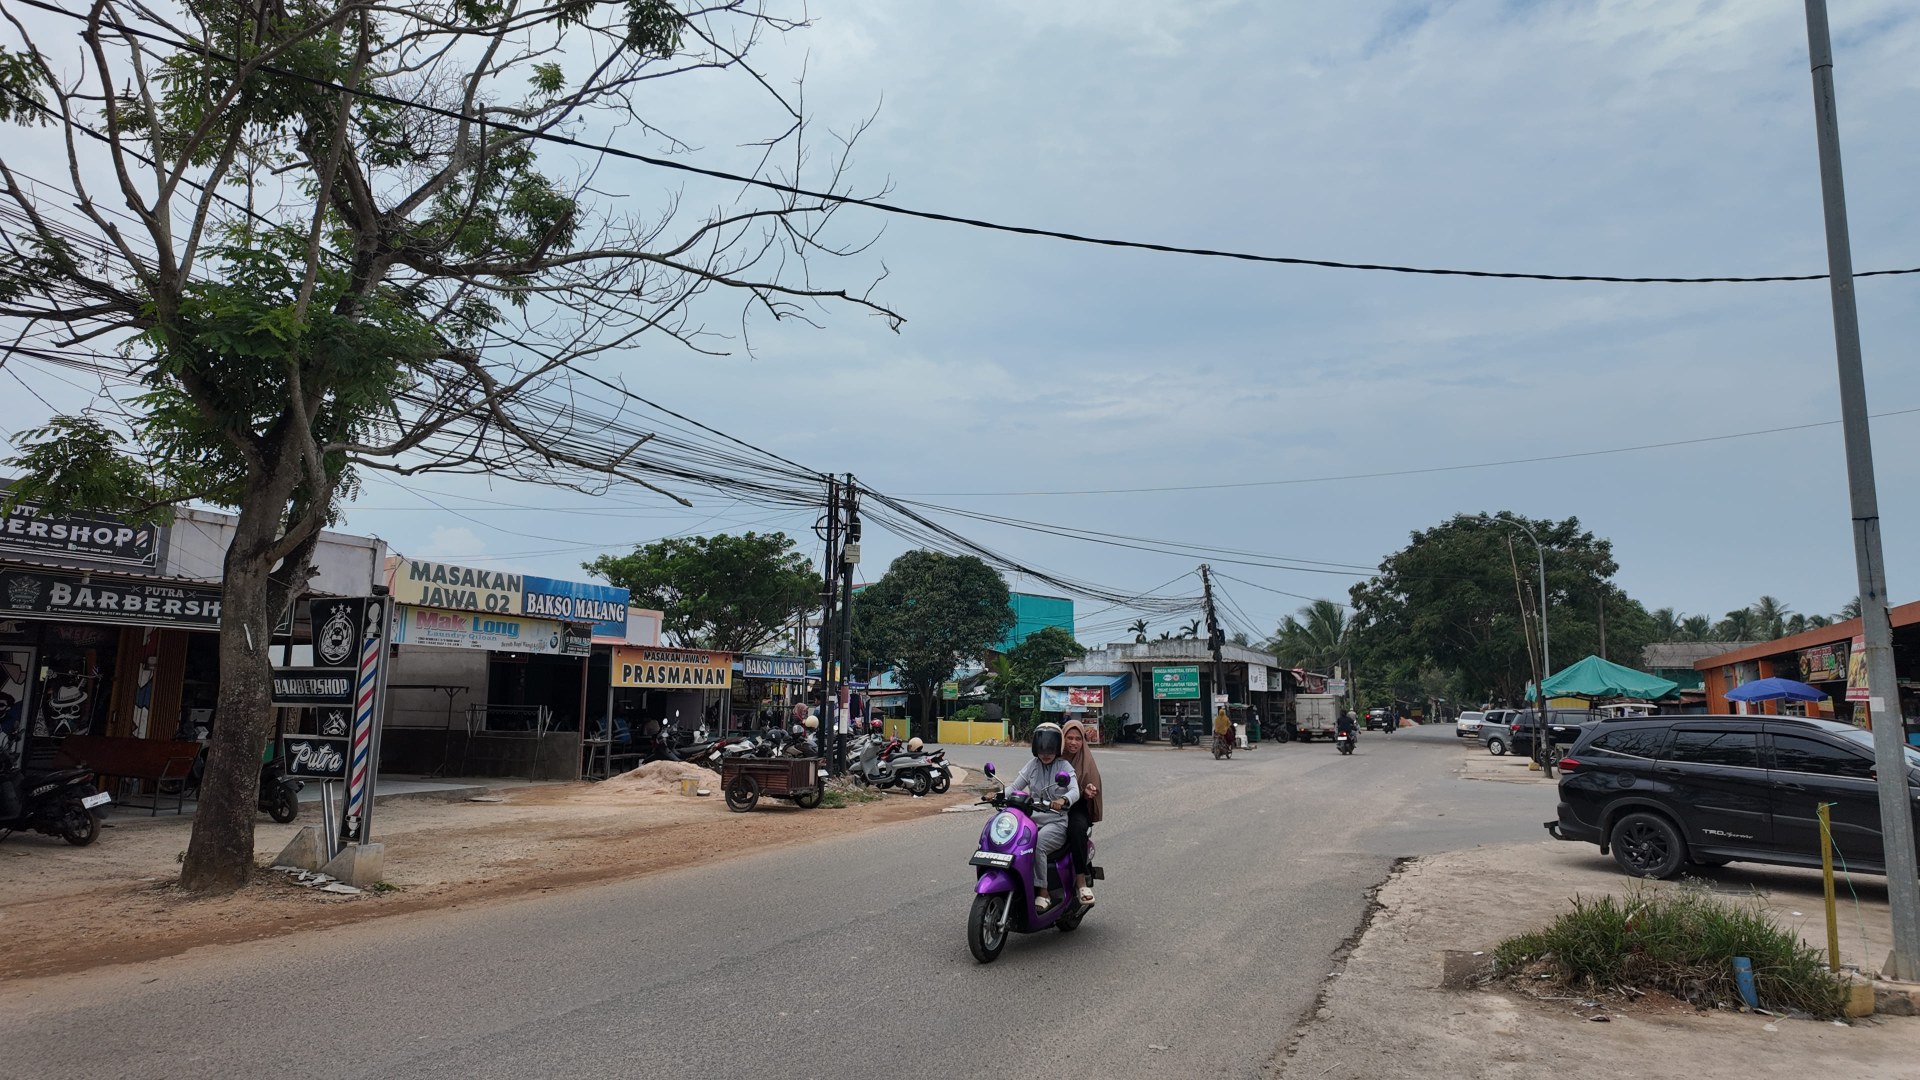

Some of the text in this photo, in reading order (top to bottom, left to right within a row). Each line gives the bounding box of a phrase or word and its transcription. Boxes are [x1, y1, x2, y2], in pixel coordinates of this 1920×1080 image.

[0, 516, 134, 547] ERSHOP
[409, 560, 521, 593] MASAKAN
[50, 582, 221, 617] BARBERSH
[144, 586, 185, 598] PUTRA
[419, 585, 510, 613] JAWA 02
[526, 592, 625, 623] BAKSO MALANG
[415, 611, 520, 639] Mak Long
[427, 630, 467, 640] Laundry
[644, 651, 710, 664] MASAKAN JAWA 02
[746, 659, 804, 676] BAKSO MALANG
[274, 678, 350, 697] BARBERSHOP
[622, 664, 725, 685] PRASMANAN
[291, 742, 342, 773] Putra
